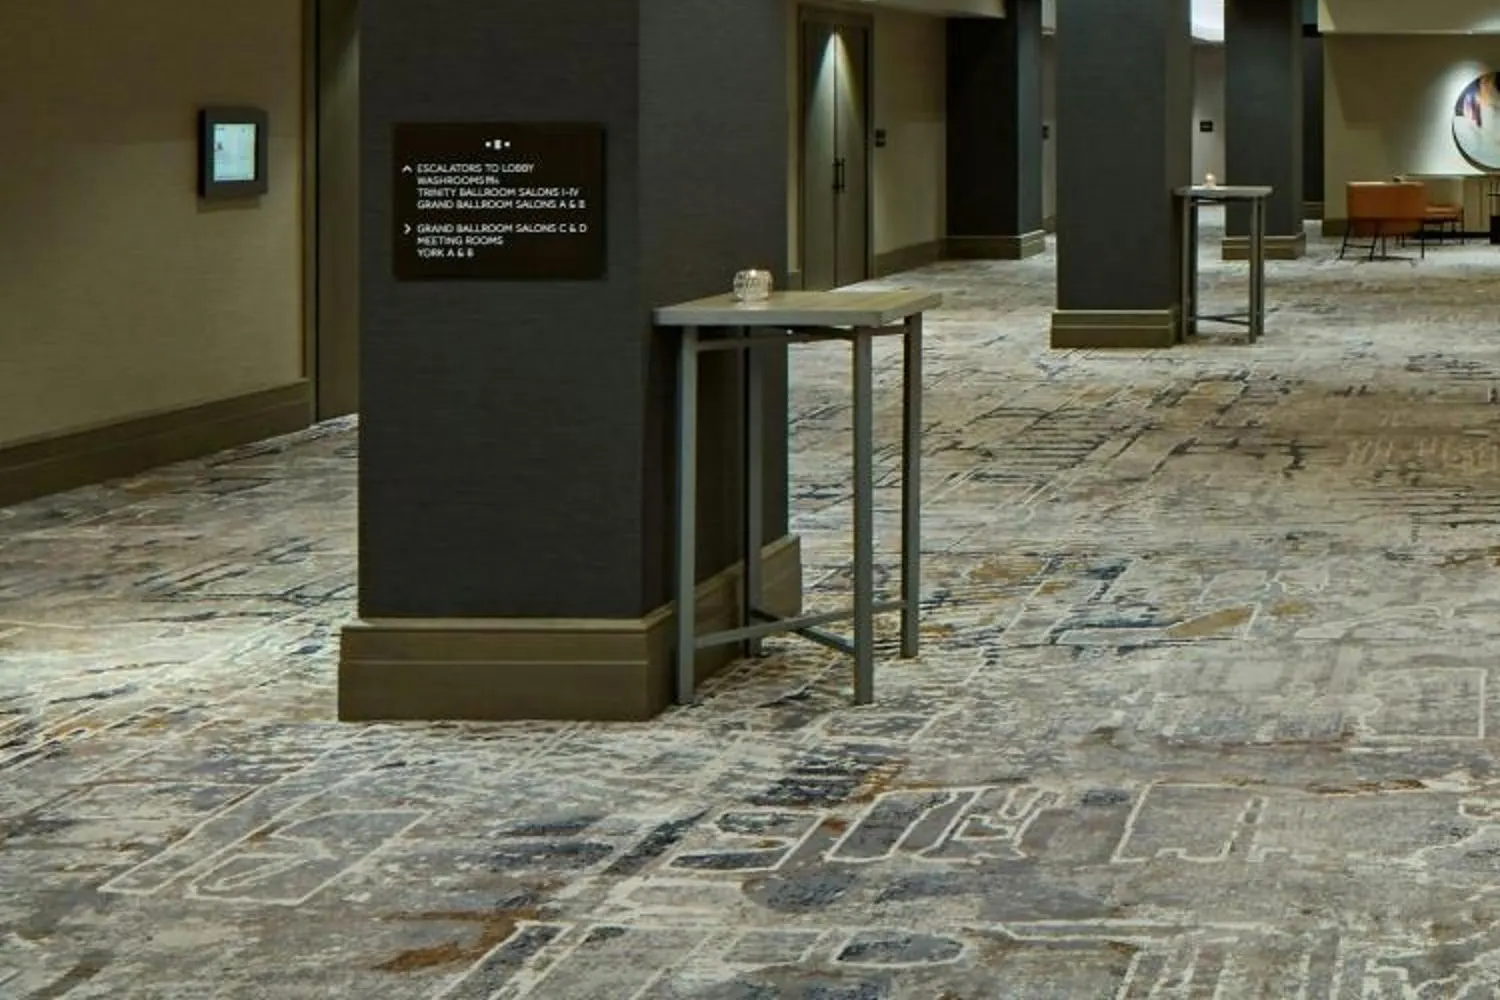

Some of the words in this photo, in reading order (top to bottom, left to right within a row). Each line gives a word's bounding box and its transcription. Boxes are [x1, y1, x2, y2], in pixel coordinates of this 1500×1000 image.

[417, 164, 482, 172] ESCALATORS
[485, 164, 499, 172] TO
[502, 164, 534, 172] LOBBY
[460, 188, 516, 196] BALLROOM
[519, 188, 560, 196] SALONS
[417, 200, 454, 209] GRAND
[456, 200, 512, 209] BALLROOM
[516, 200, 556, 209] SALONS
[560, 200, 567, 209] A
[417, 224, 454, 233] GRAND
[456, 224, 512, 233] BALLROOM
[516, 224, 556, 233] SALONS
[559, 224, 566, 233] C
[579, 224, 587, 233] D
[417, 236, 463, 245] MEETING
[466, 236, 503, 245] ROOMS
[418, 248, 444, 257] YORK
[447, 248, 455, 257] A
